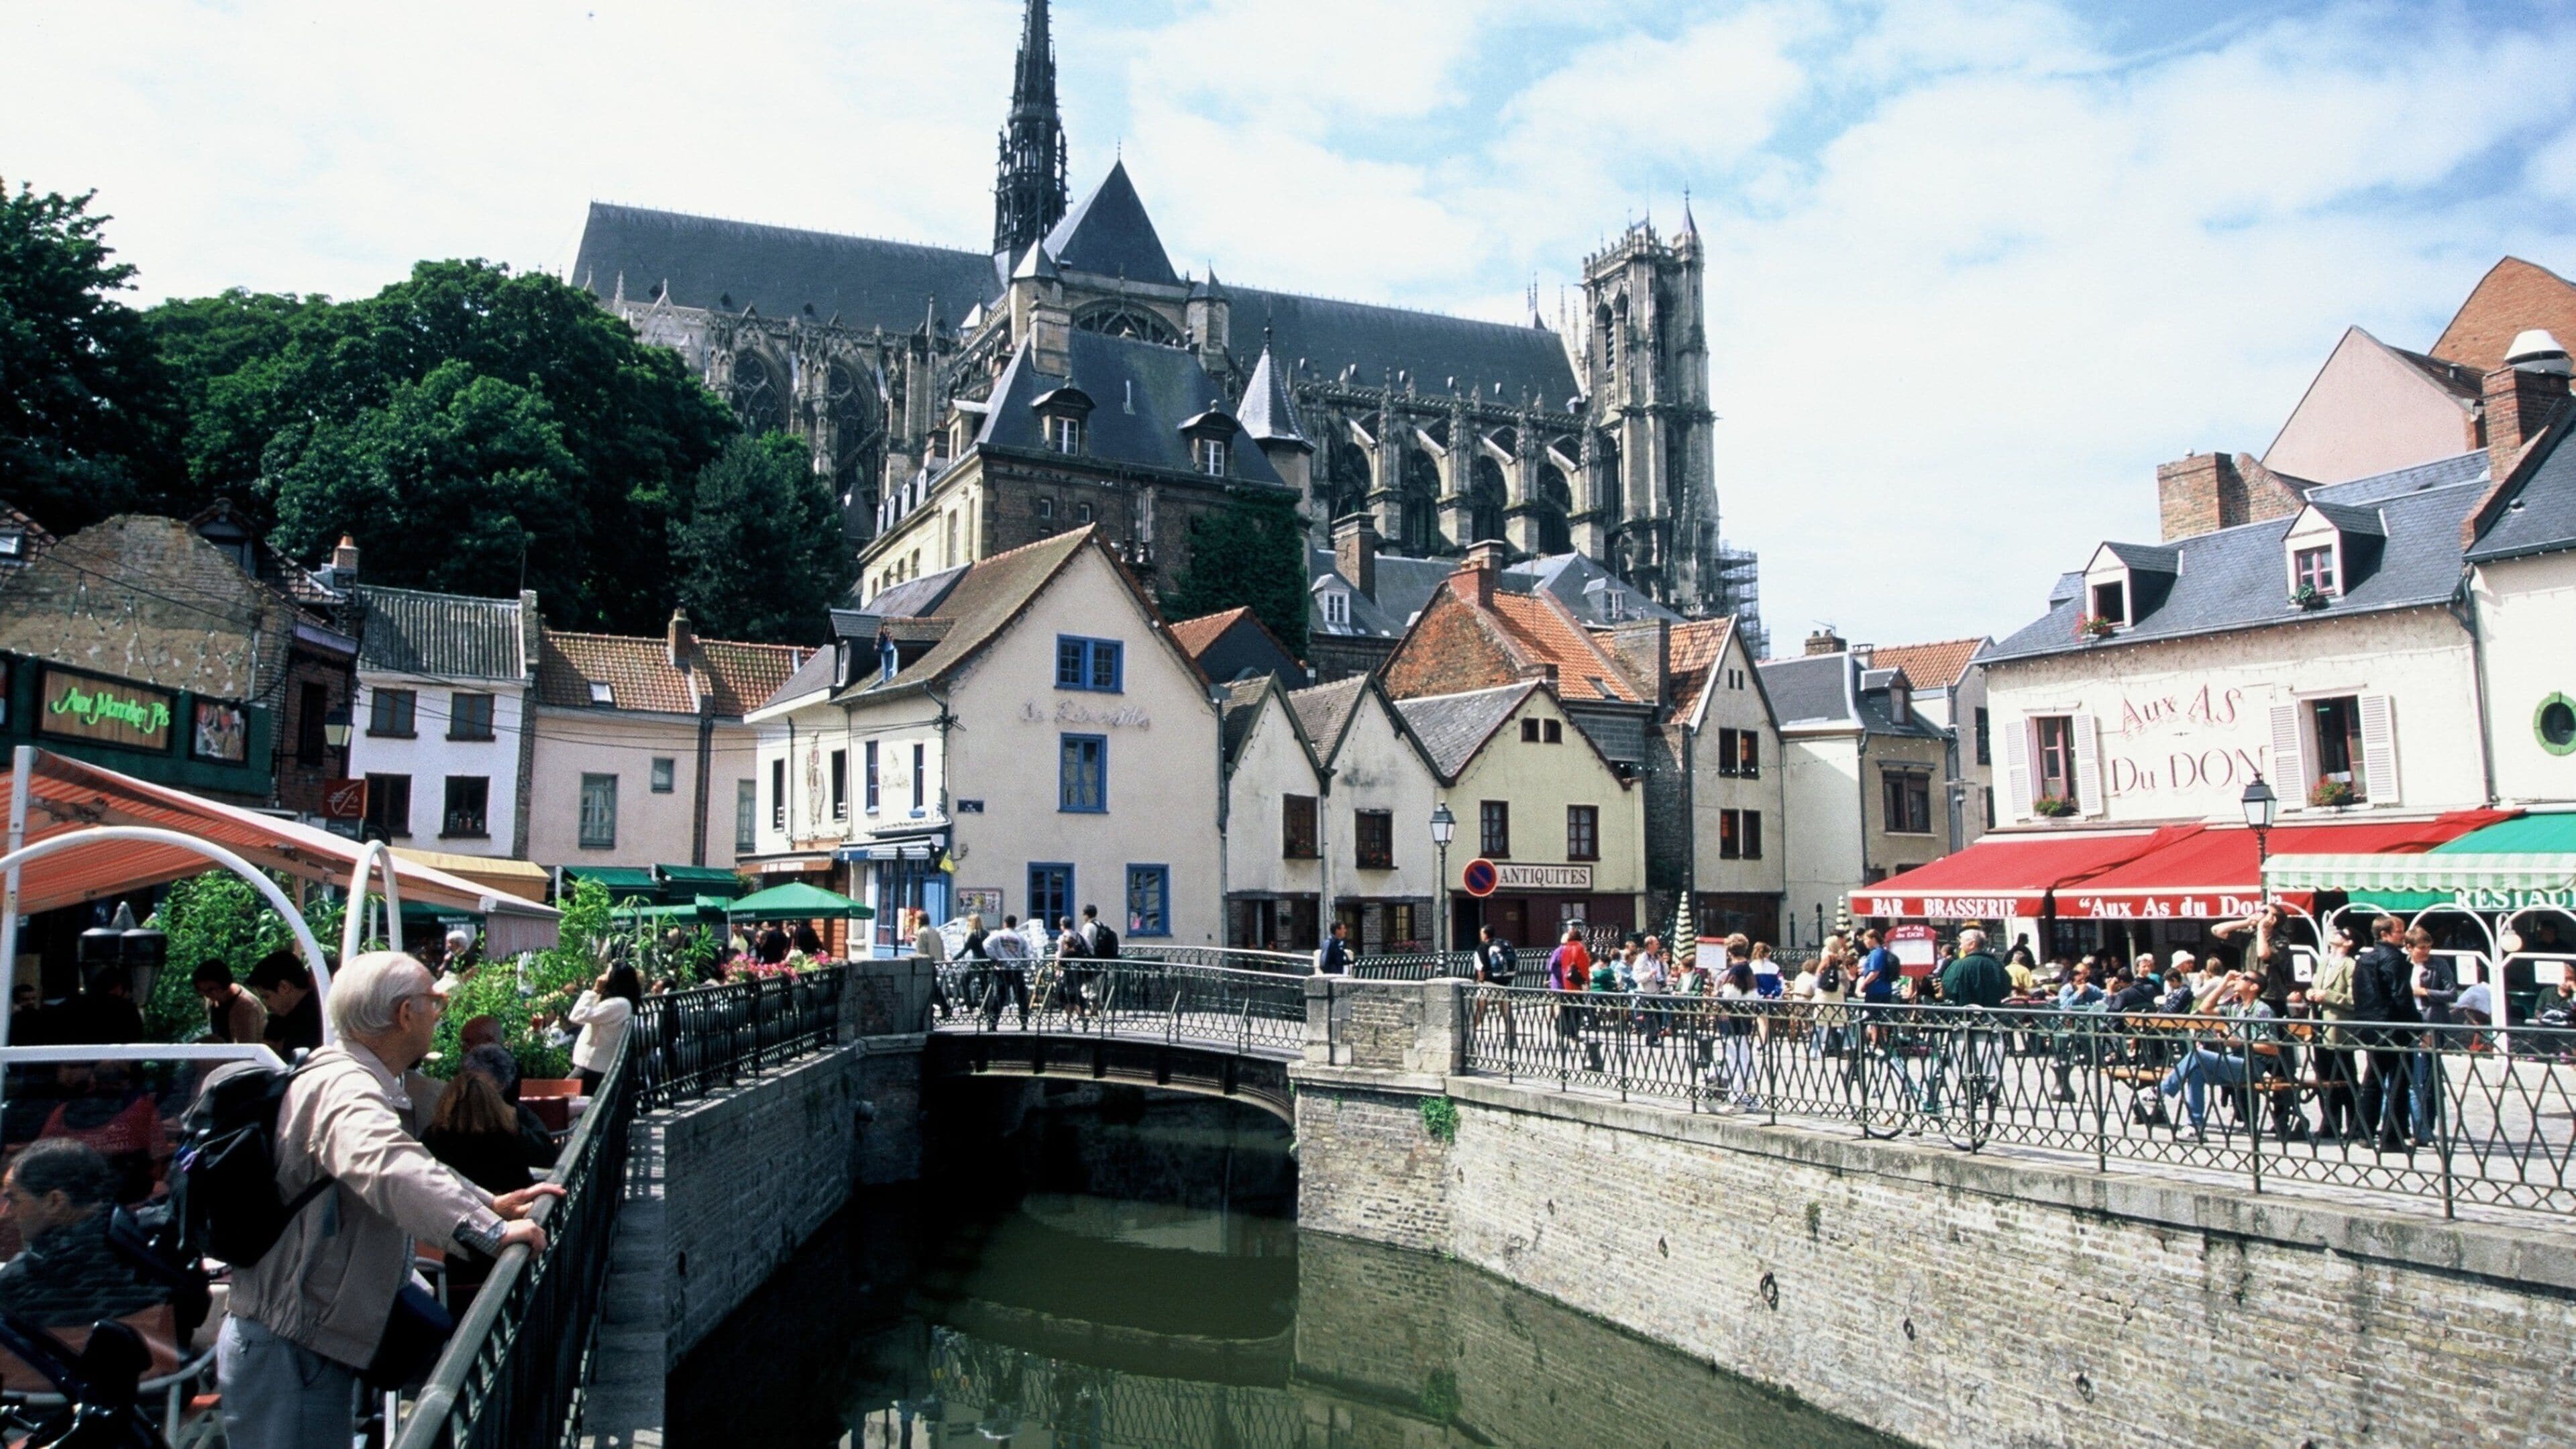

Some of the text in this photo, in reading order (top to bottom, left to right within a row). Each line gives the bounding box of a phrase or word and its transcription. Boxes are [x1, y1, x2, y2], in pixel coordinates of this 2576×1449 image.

[2121, 682, 2243, 734] Aux AS
[2111, 747, 2271, 792] Du DON
[1500, 867, 1587, 887] ANTIQUITES
[1872, 898, 2018, 918] BAR BRASSERIE
[2142, 897, 2170, 917] As
[2180, 896, 2207, 917] du
